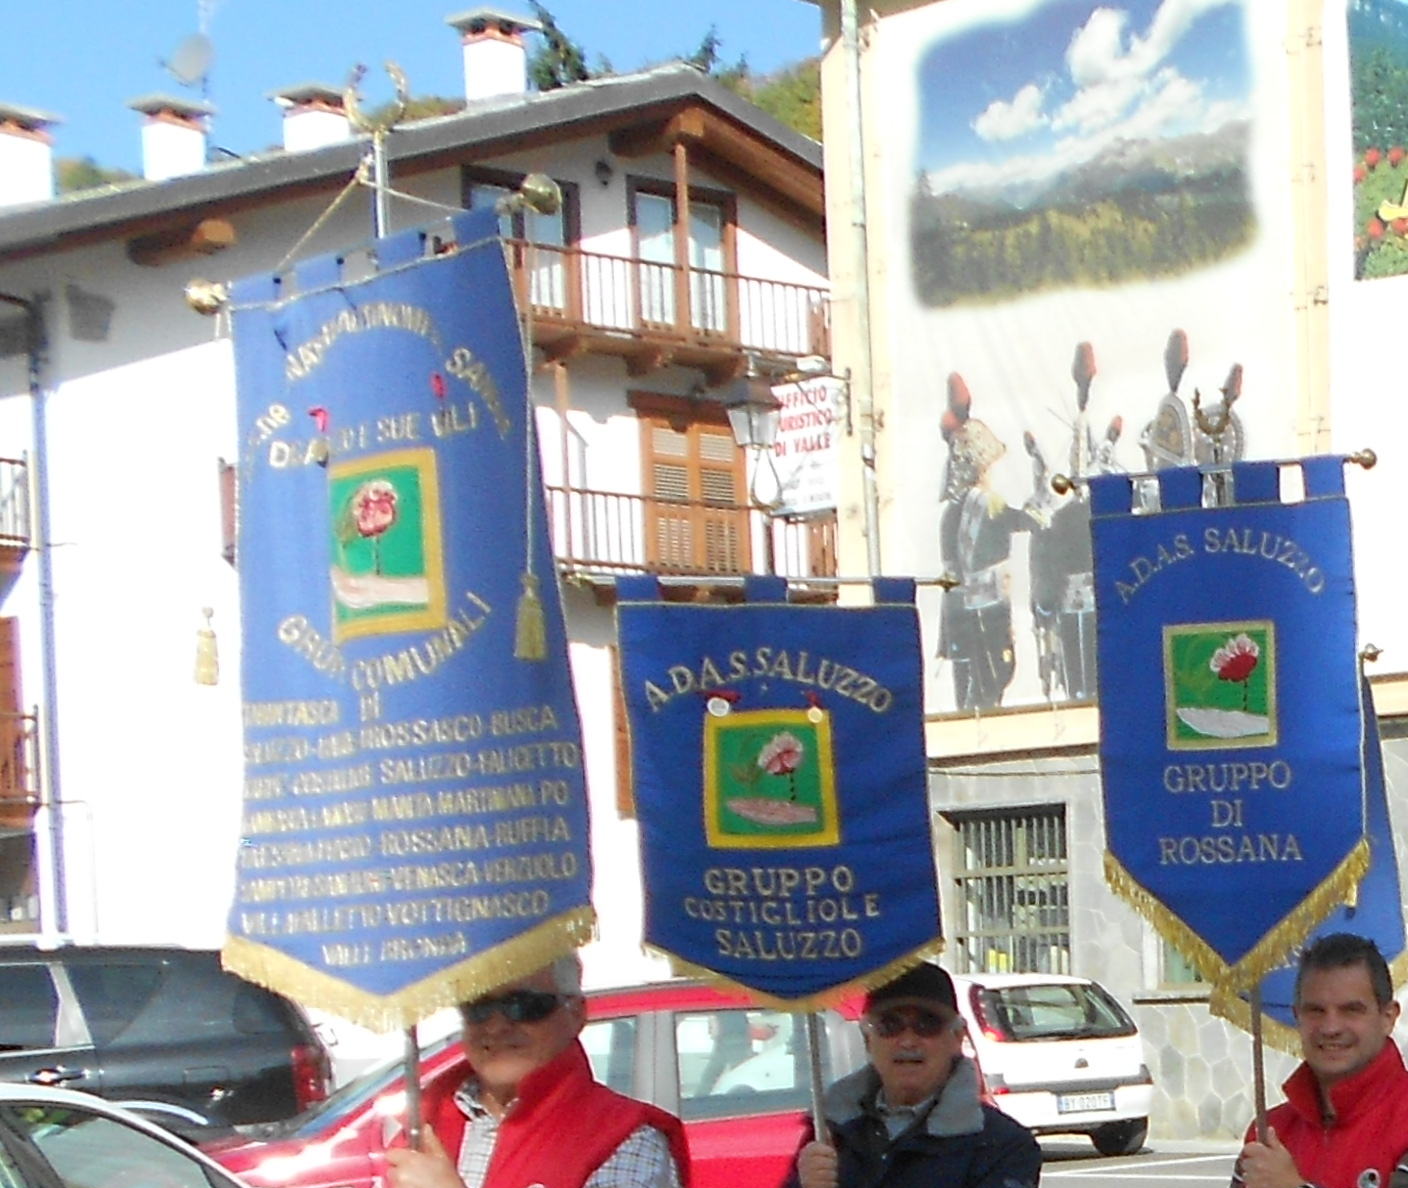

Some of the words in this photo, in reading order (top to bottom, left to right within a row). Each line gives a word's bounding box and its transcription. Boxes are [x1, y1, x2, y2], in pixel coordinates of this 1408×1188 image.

[780, 408, 833, 432] URISTICO
[775, 441, 787, 457] DI
[794, 432, 830, 453] VALLE
[1113, 533, 1195, 605] A.D.A.S.
[1203, 528, 1326, 595] SALUZZO
[753, 647, 893, 713] SALUZZO
[1163, 761, 1291, 793] GRUPPO
[1210, 799, 1244, 828] DI
[1159, 834, 1303, 866] ROSSANA
[703, 864, 855, 897] GRUPPO
[715, 929, 862, 960] SALUZZO
